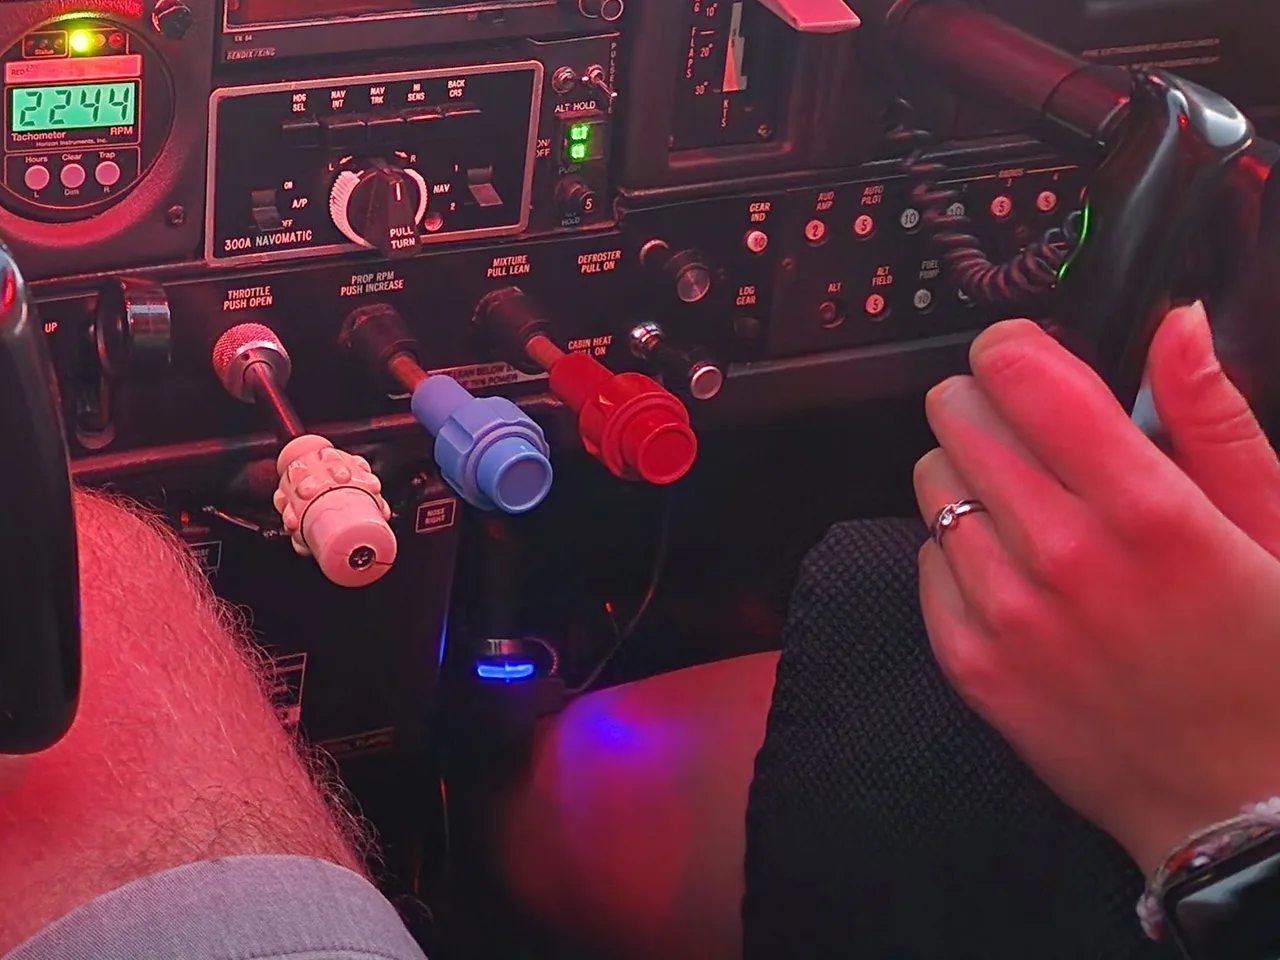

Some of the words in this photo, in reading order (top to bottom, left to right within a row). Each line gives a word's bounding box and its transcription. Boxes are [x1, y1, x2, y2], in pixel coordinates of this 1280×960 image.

[19, 87, 130, 127] 2244
[573, 101, 596, 110] HOLD
[11, 131, 66, 141] Tachometer
[110, 126, 133, 136] RPM
[25, 155, 48, 163] Hours
[62, 153, 82, 161] Clear
[863, 185, 884, 195] AUTO
[750, 202, 771, 212] GEAR
[861, 195, 882, 205] PILOT
[389, 227, 414, 238] PULL
[224, 238, 252, 251] 300A
[255, 231, 313, 247] NAVOMATIC
[391, 238, 416, 250] TURN
[492, 255, 528, 267] MIXTURE
[577, 250, 621, 265] DEFROSTER
[487, 267, 507, 278] PULL
[510, 263, 530, 274] LEAN
[581, 262, 602, 274] PULL
[604, 260, 616, 271] ON
[351, 273, 373, 285] PROP
[376, 271, 396, 282] RPM
[227, 285, 271, 300] THROTTLE
[340, 285, 363, 297] PUSH
[365, 279, 404, 293] INCREASE
[223, 298, 247, 311] PUSH
[249, 295, 273, 307] OPEN
[568, 338, 591, 350] CABIN
[593, 335, 613, 346] HEAT
